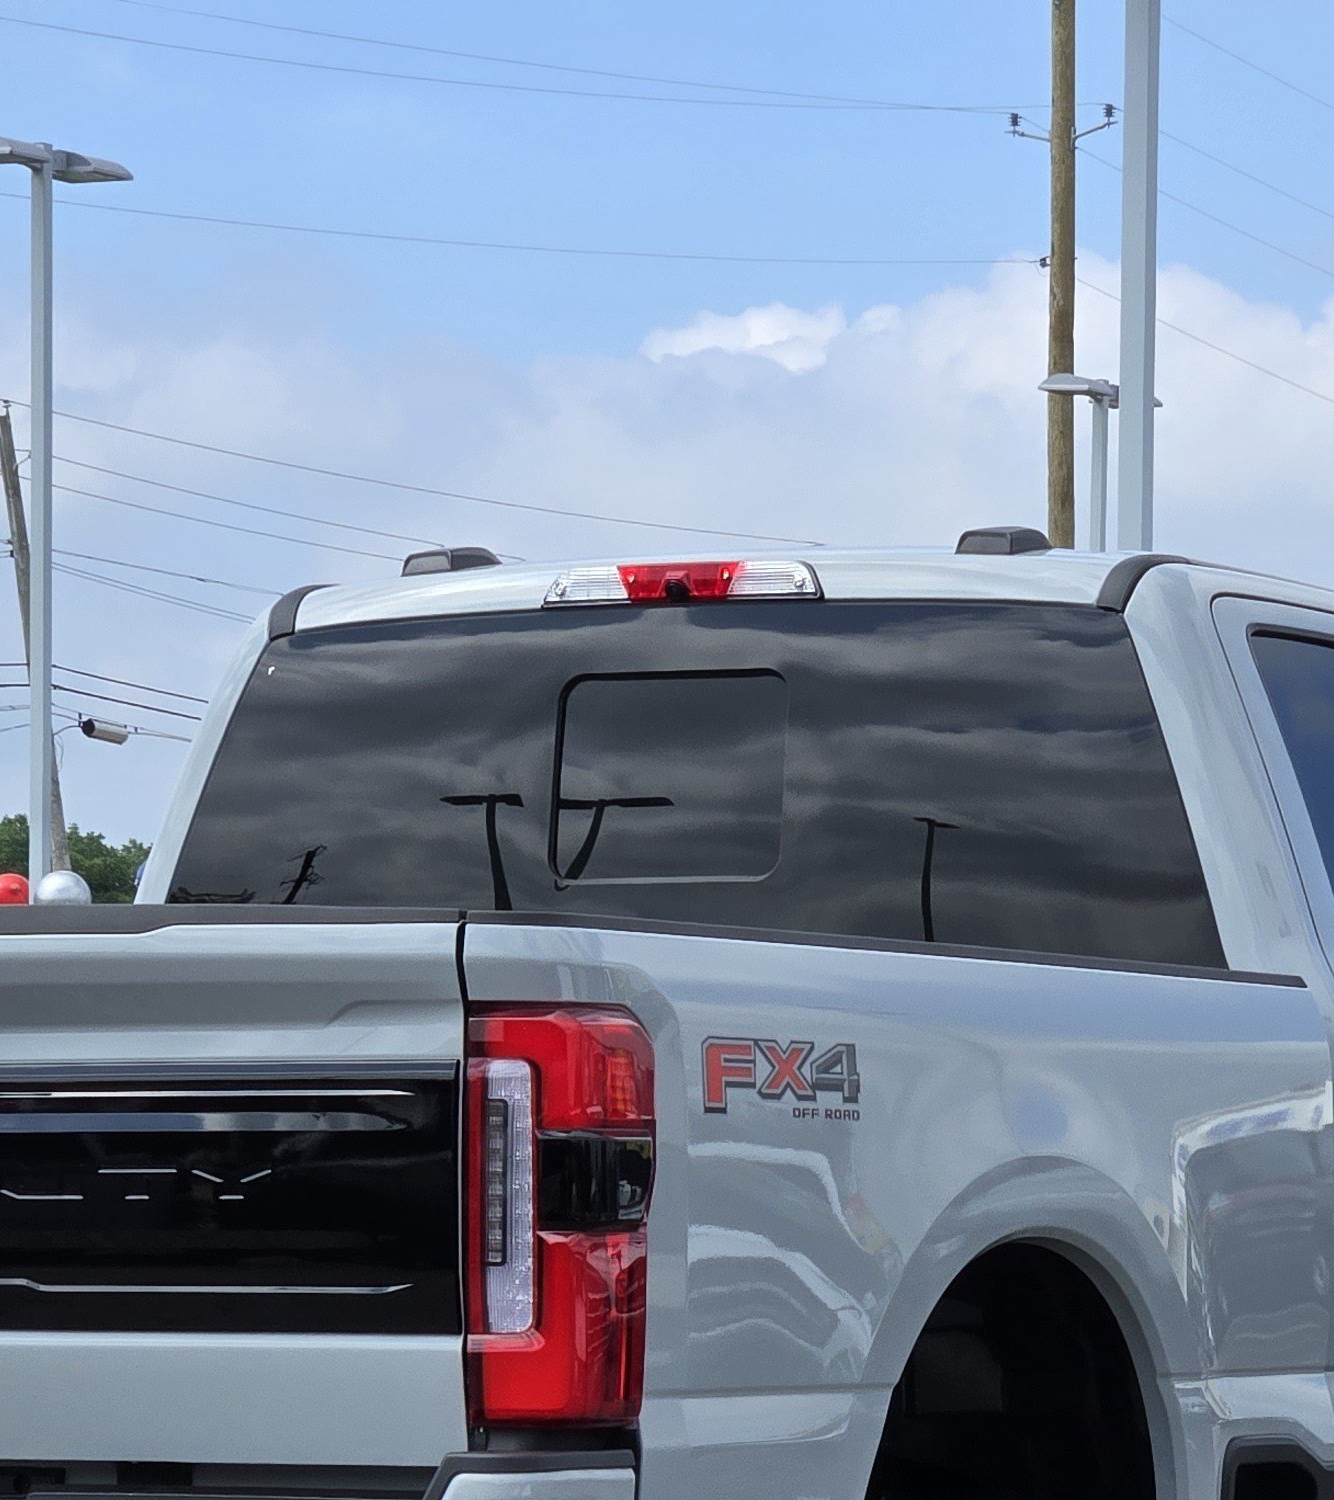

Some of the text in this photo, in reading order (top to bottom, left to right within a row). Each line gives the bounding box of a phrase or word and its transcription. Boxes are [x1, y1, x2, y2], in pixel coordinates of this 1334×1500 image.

[702, 1036, 860, 1114] FX4
[793, 1107, 860, 1121] OFF ROAD
